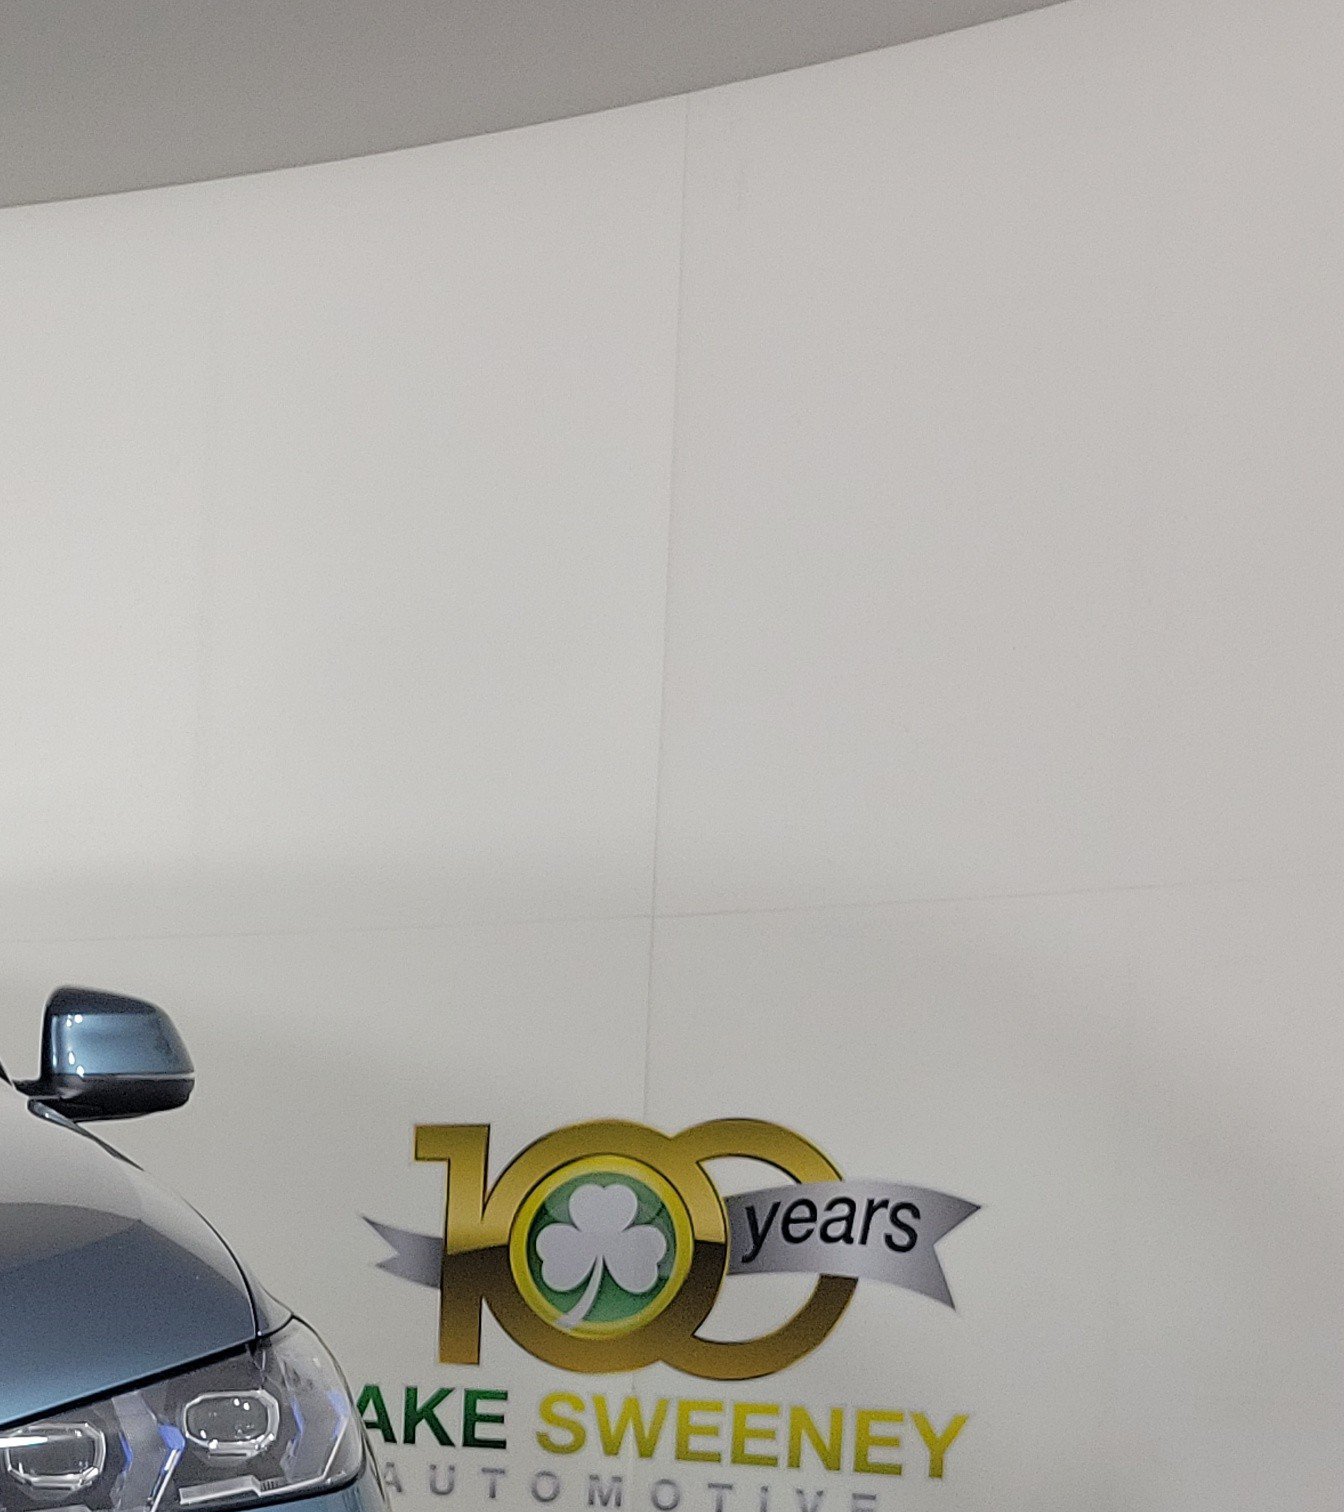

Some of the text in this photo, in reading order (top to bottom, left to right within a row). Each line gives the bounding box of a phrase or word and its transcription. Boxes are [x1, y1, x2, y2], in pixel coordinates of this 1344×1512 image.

[414, 1117, 859, 1381] 100
[740, 1195, 922, 1264] years
[355, 1383, 970, 1480] AKE SWEENEY
